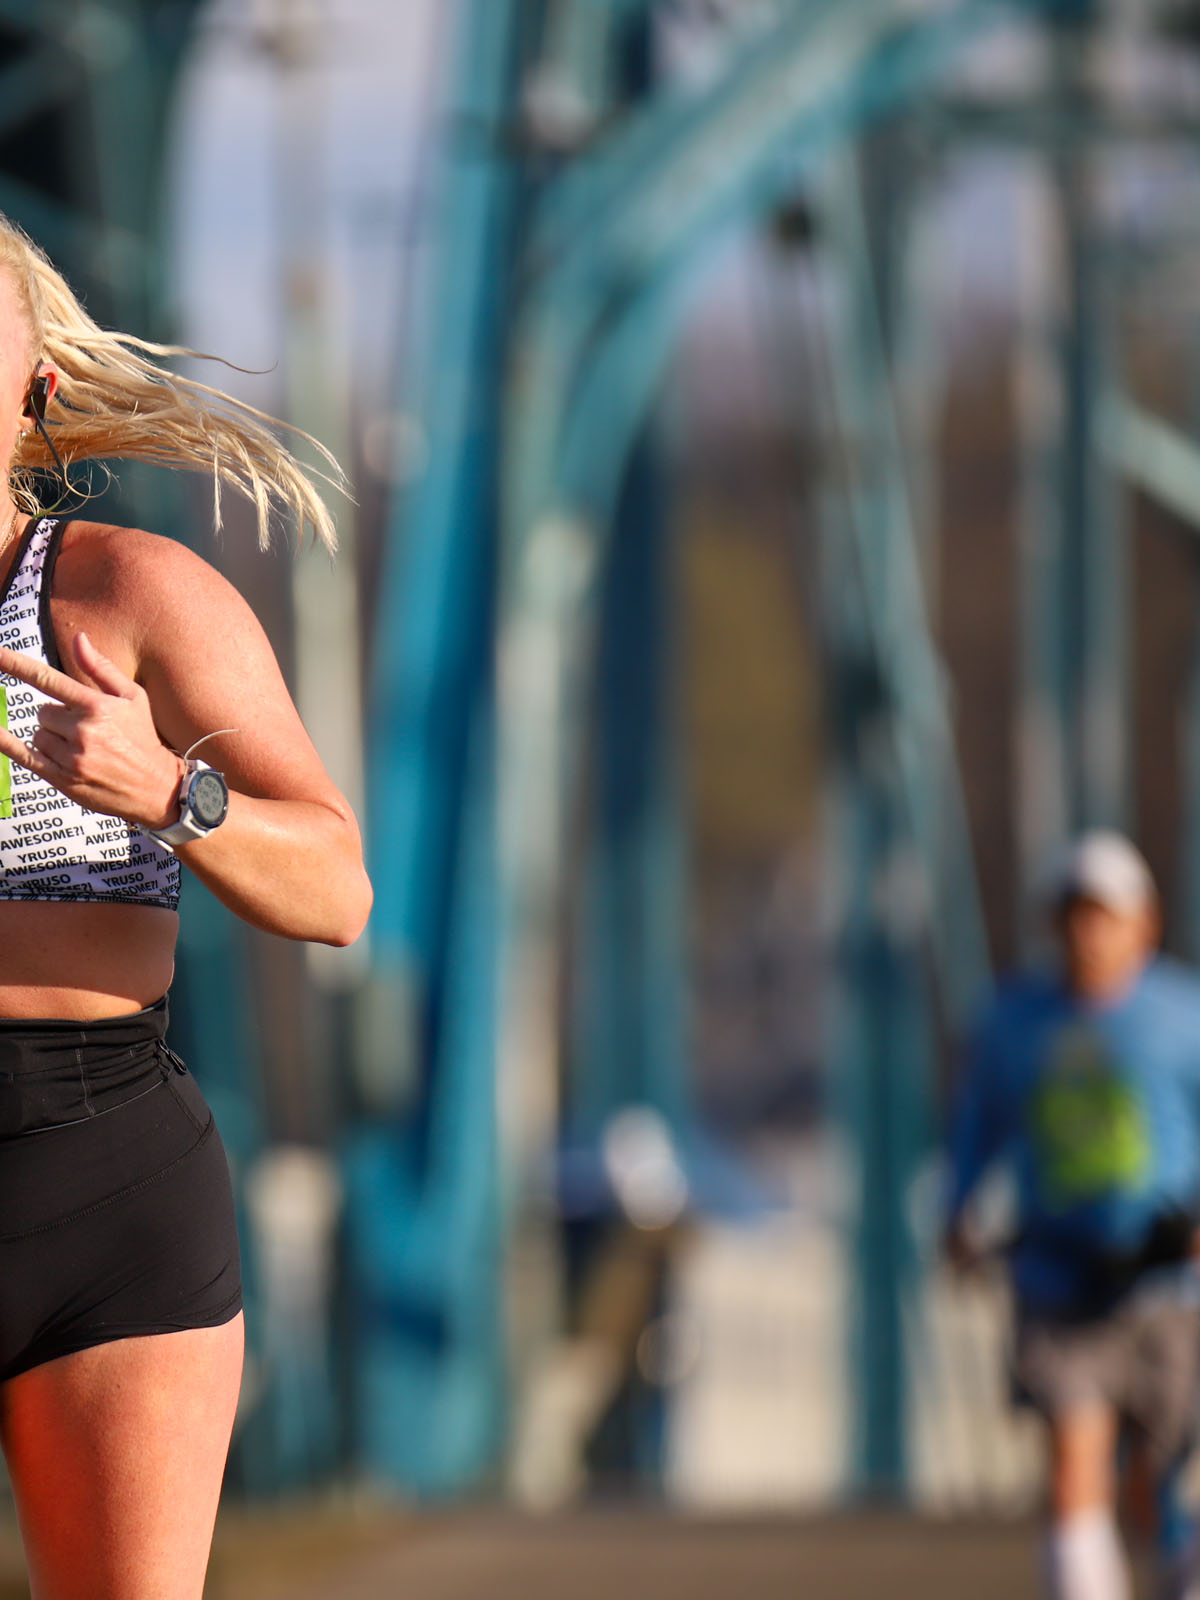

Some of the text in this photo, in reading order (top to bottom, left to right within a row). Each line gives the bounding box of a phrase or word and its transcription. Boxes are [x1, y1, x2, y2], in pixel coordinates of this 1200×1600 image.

[7, 691, 33, 706] USO
[12, 816, 63, 836] YRUSO
[0, 825, 85, 851] AWESOME?!
[17, 846, 68, 864] YRUSO
[99, 843, 142, 860] YRUSO
[5, 854, 88, 877] AWESOME?!
[87, 851, 157, 875] AWESOME?!
[101, 871, 145, 888] YRUSO
